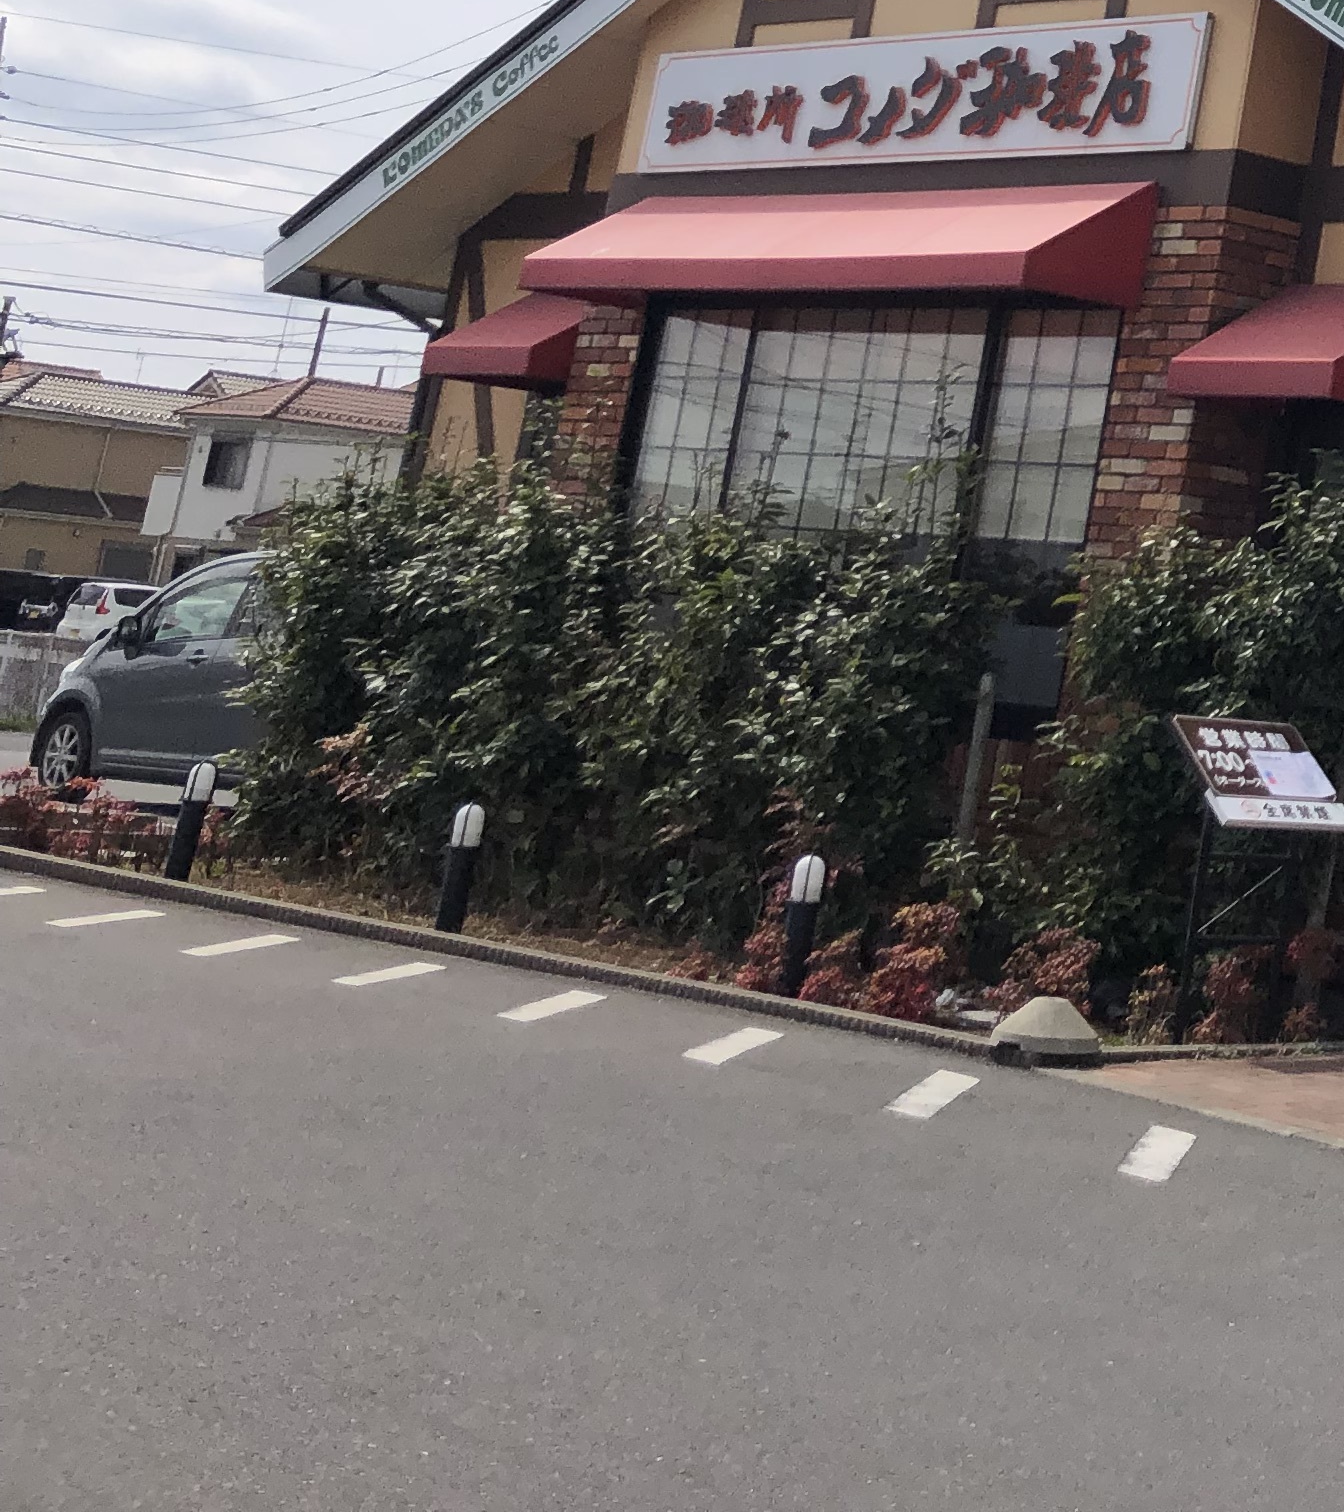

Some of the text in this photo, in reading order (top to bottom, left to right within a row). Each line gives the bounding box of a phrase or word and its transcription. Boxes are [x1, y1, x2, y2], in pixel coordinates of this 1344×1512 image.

[381, 34, 560, 189] KOMEDA'S Coffee
[808, 29, 1152, 150] コメダ珈琲店
